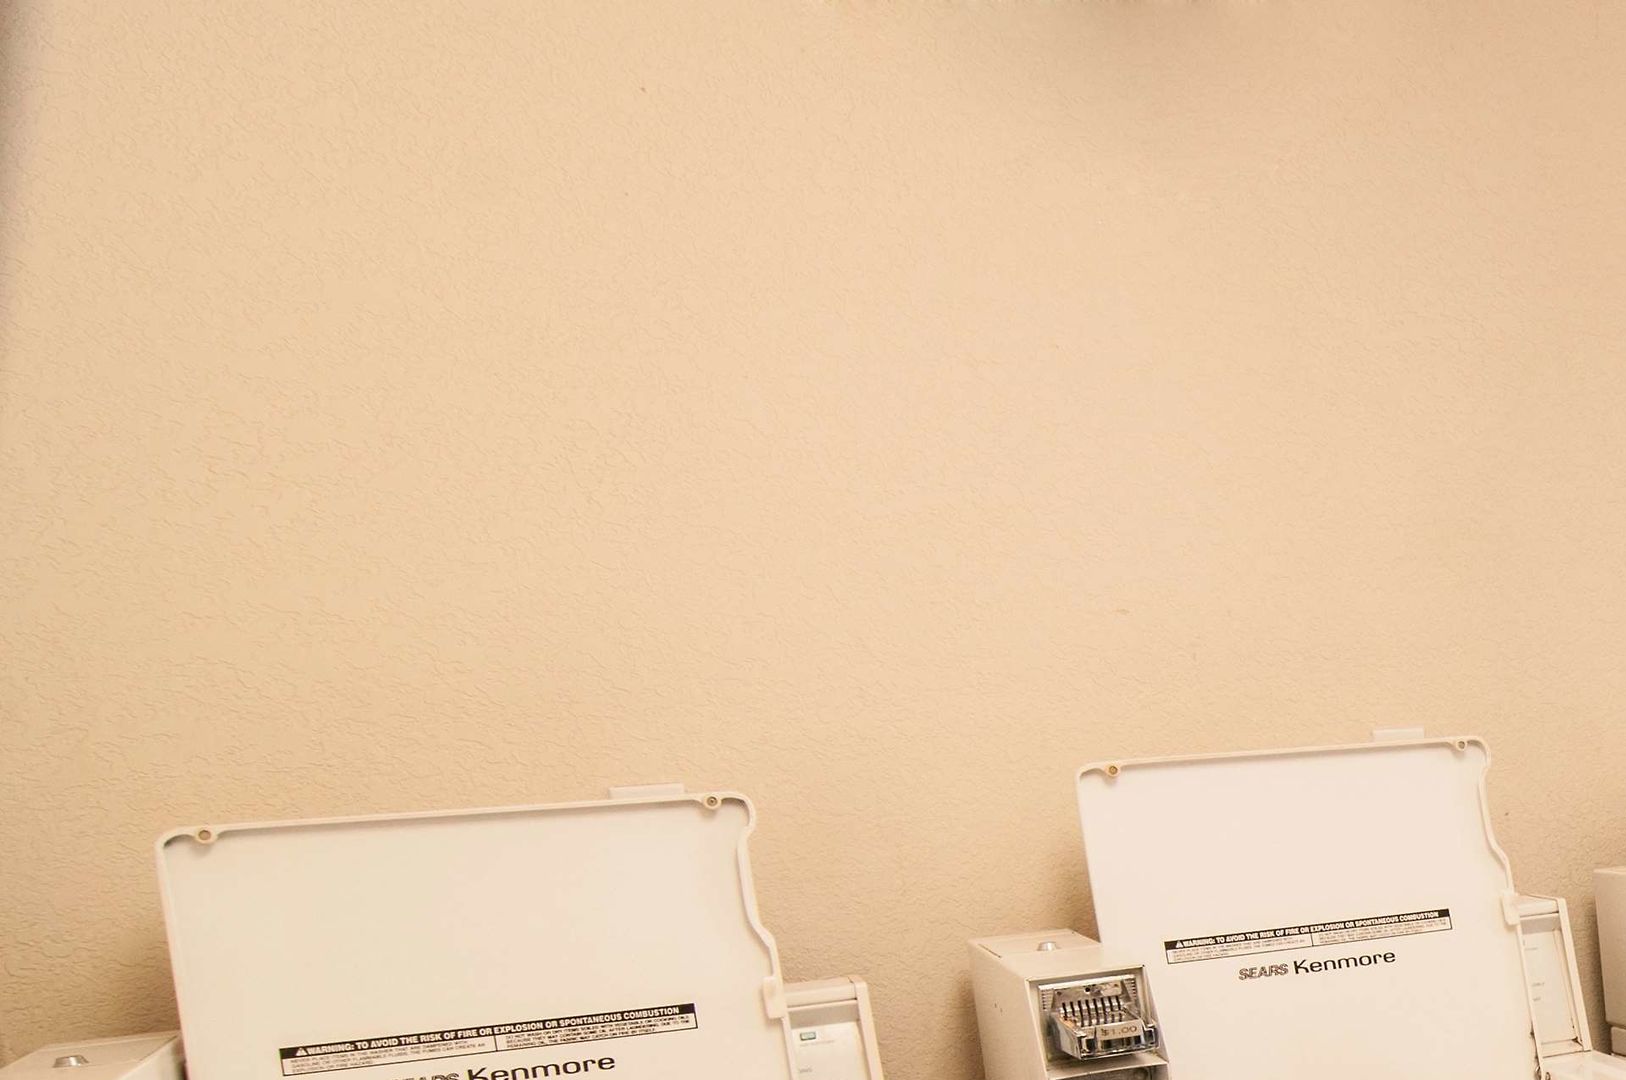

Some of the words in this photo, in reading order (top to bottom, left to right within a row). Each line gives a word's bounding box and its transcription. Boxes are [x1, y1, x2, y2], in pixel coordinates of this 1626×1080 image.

[1238, 963, 1289, 980] SEARS
[1293, 951, 1396, 974] Kenmore
[306, 1043, 354, 1055] WARNING:
[355, 1042, 368, 1050] TO
[370, 1038, 398, 1048] AVOID
[400, 1036, 418, 1045] THE
[420, 1033, 442, 1043] RISK
[443, 1031, 455, 1040] OF
[457, 1029, 478, 1038] FIRE
[479, 1028, 492, 1036] OR
[493, 1022, 543, 1034] EXPLOSION
[545, 1020, 558, 1028] OR
[559, 1013, 622, 1027] SPONTANEOUS
[623, 1006, 680, 1020] COMBUSTION
